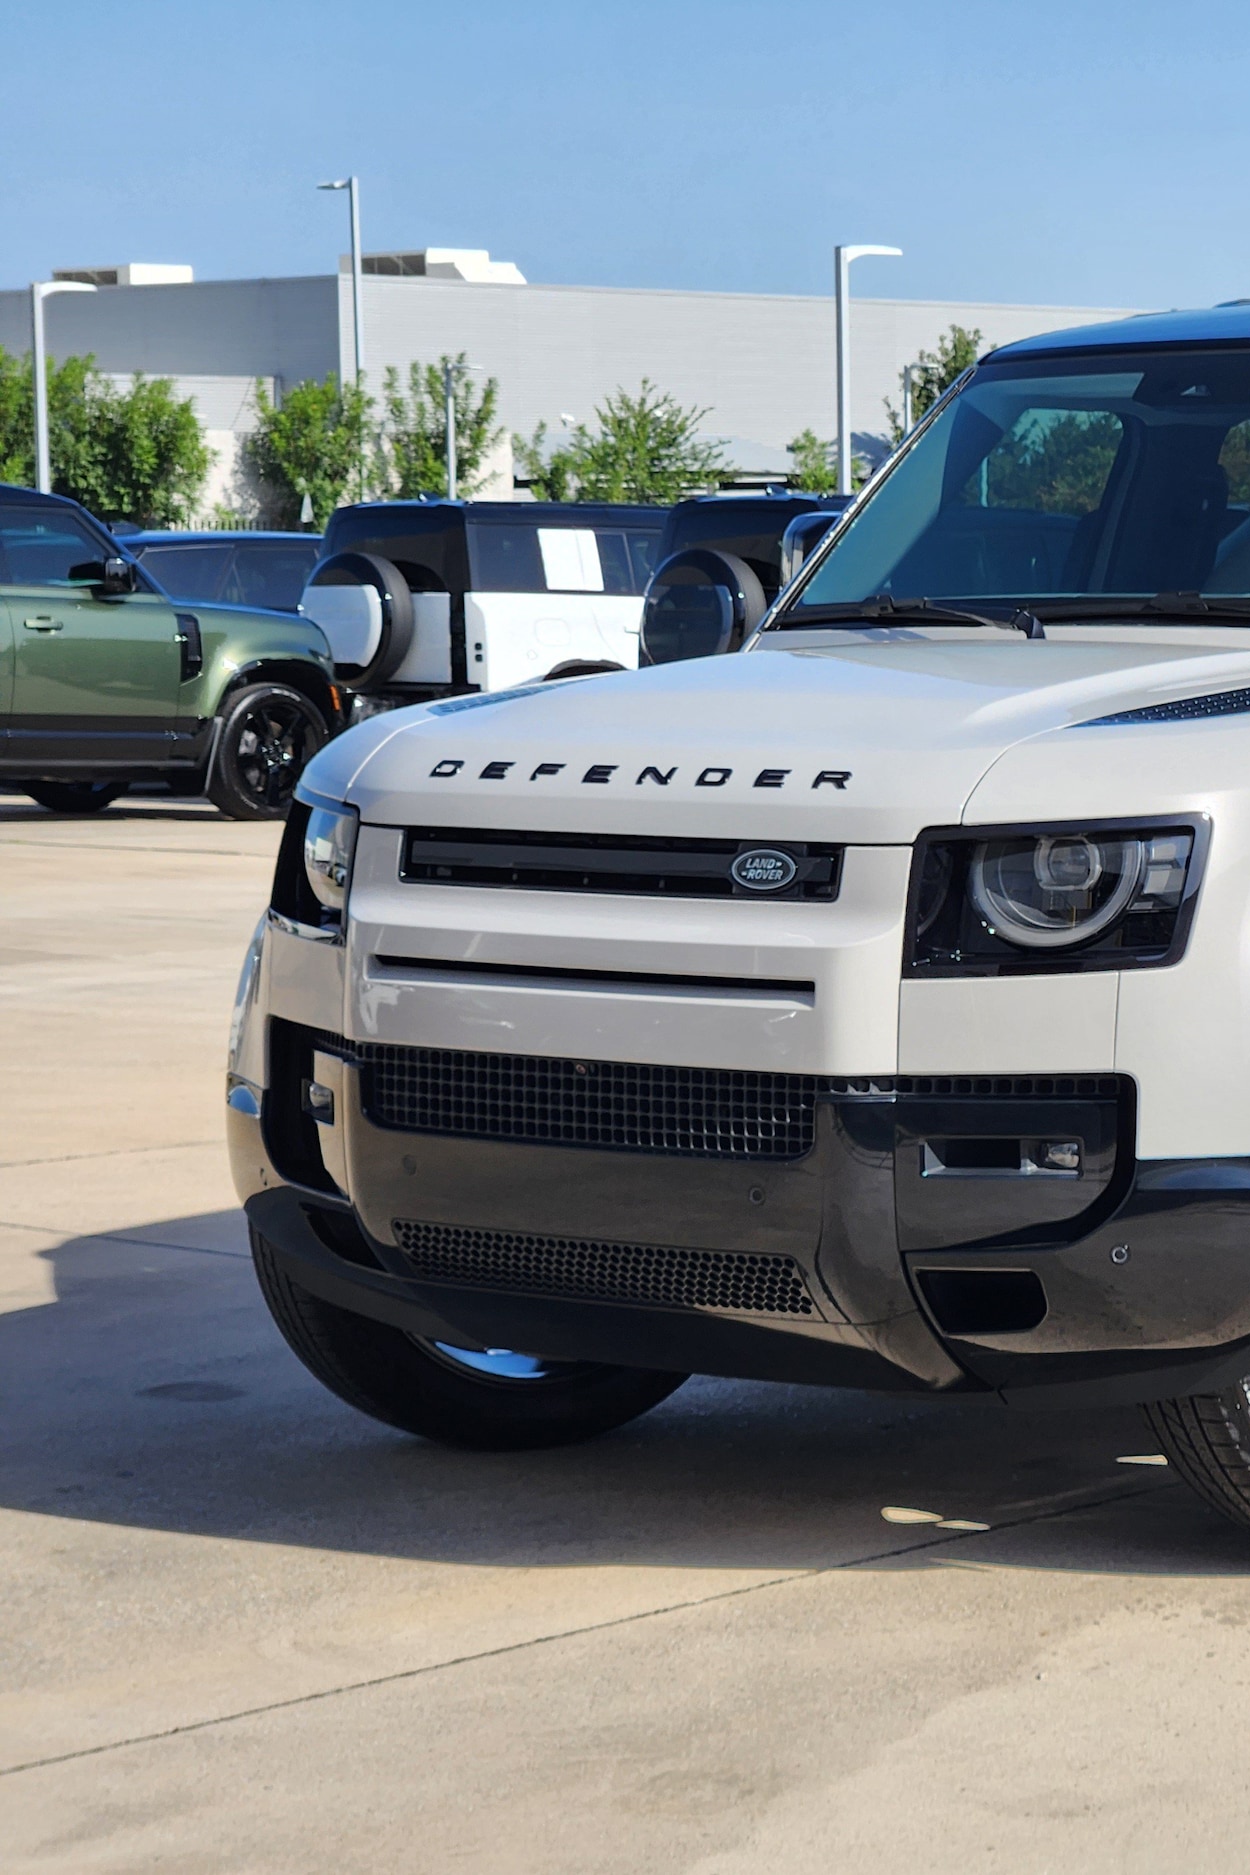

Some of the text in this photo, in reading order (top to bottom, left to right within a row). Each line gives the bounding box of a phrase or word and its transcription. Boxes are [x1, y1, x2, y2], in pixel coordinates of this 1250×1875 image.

[429, 759, 854, 790] DEFENDER
[745, 858, 776, 869] LAND
[746, 869, 784, 880] ROVER
